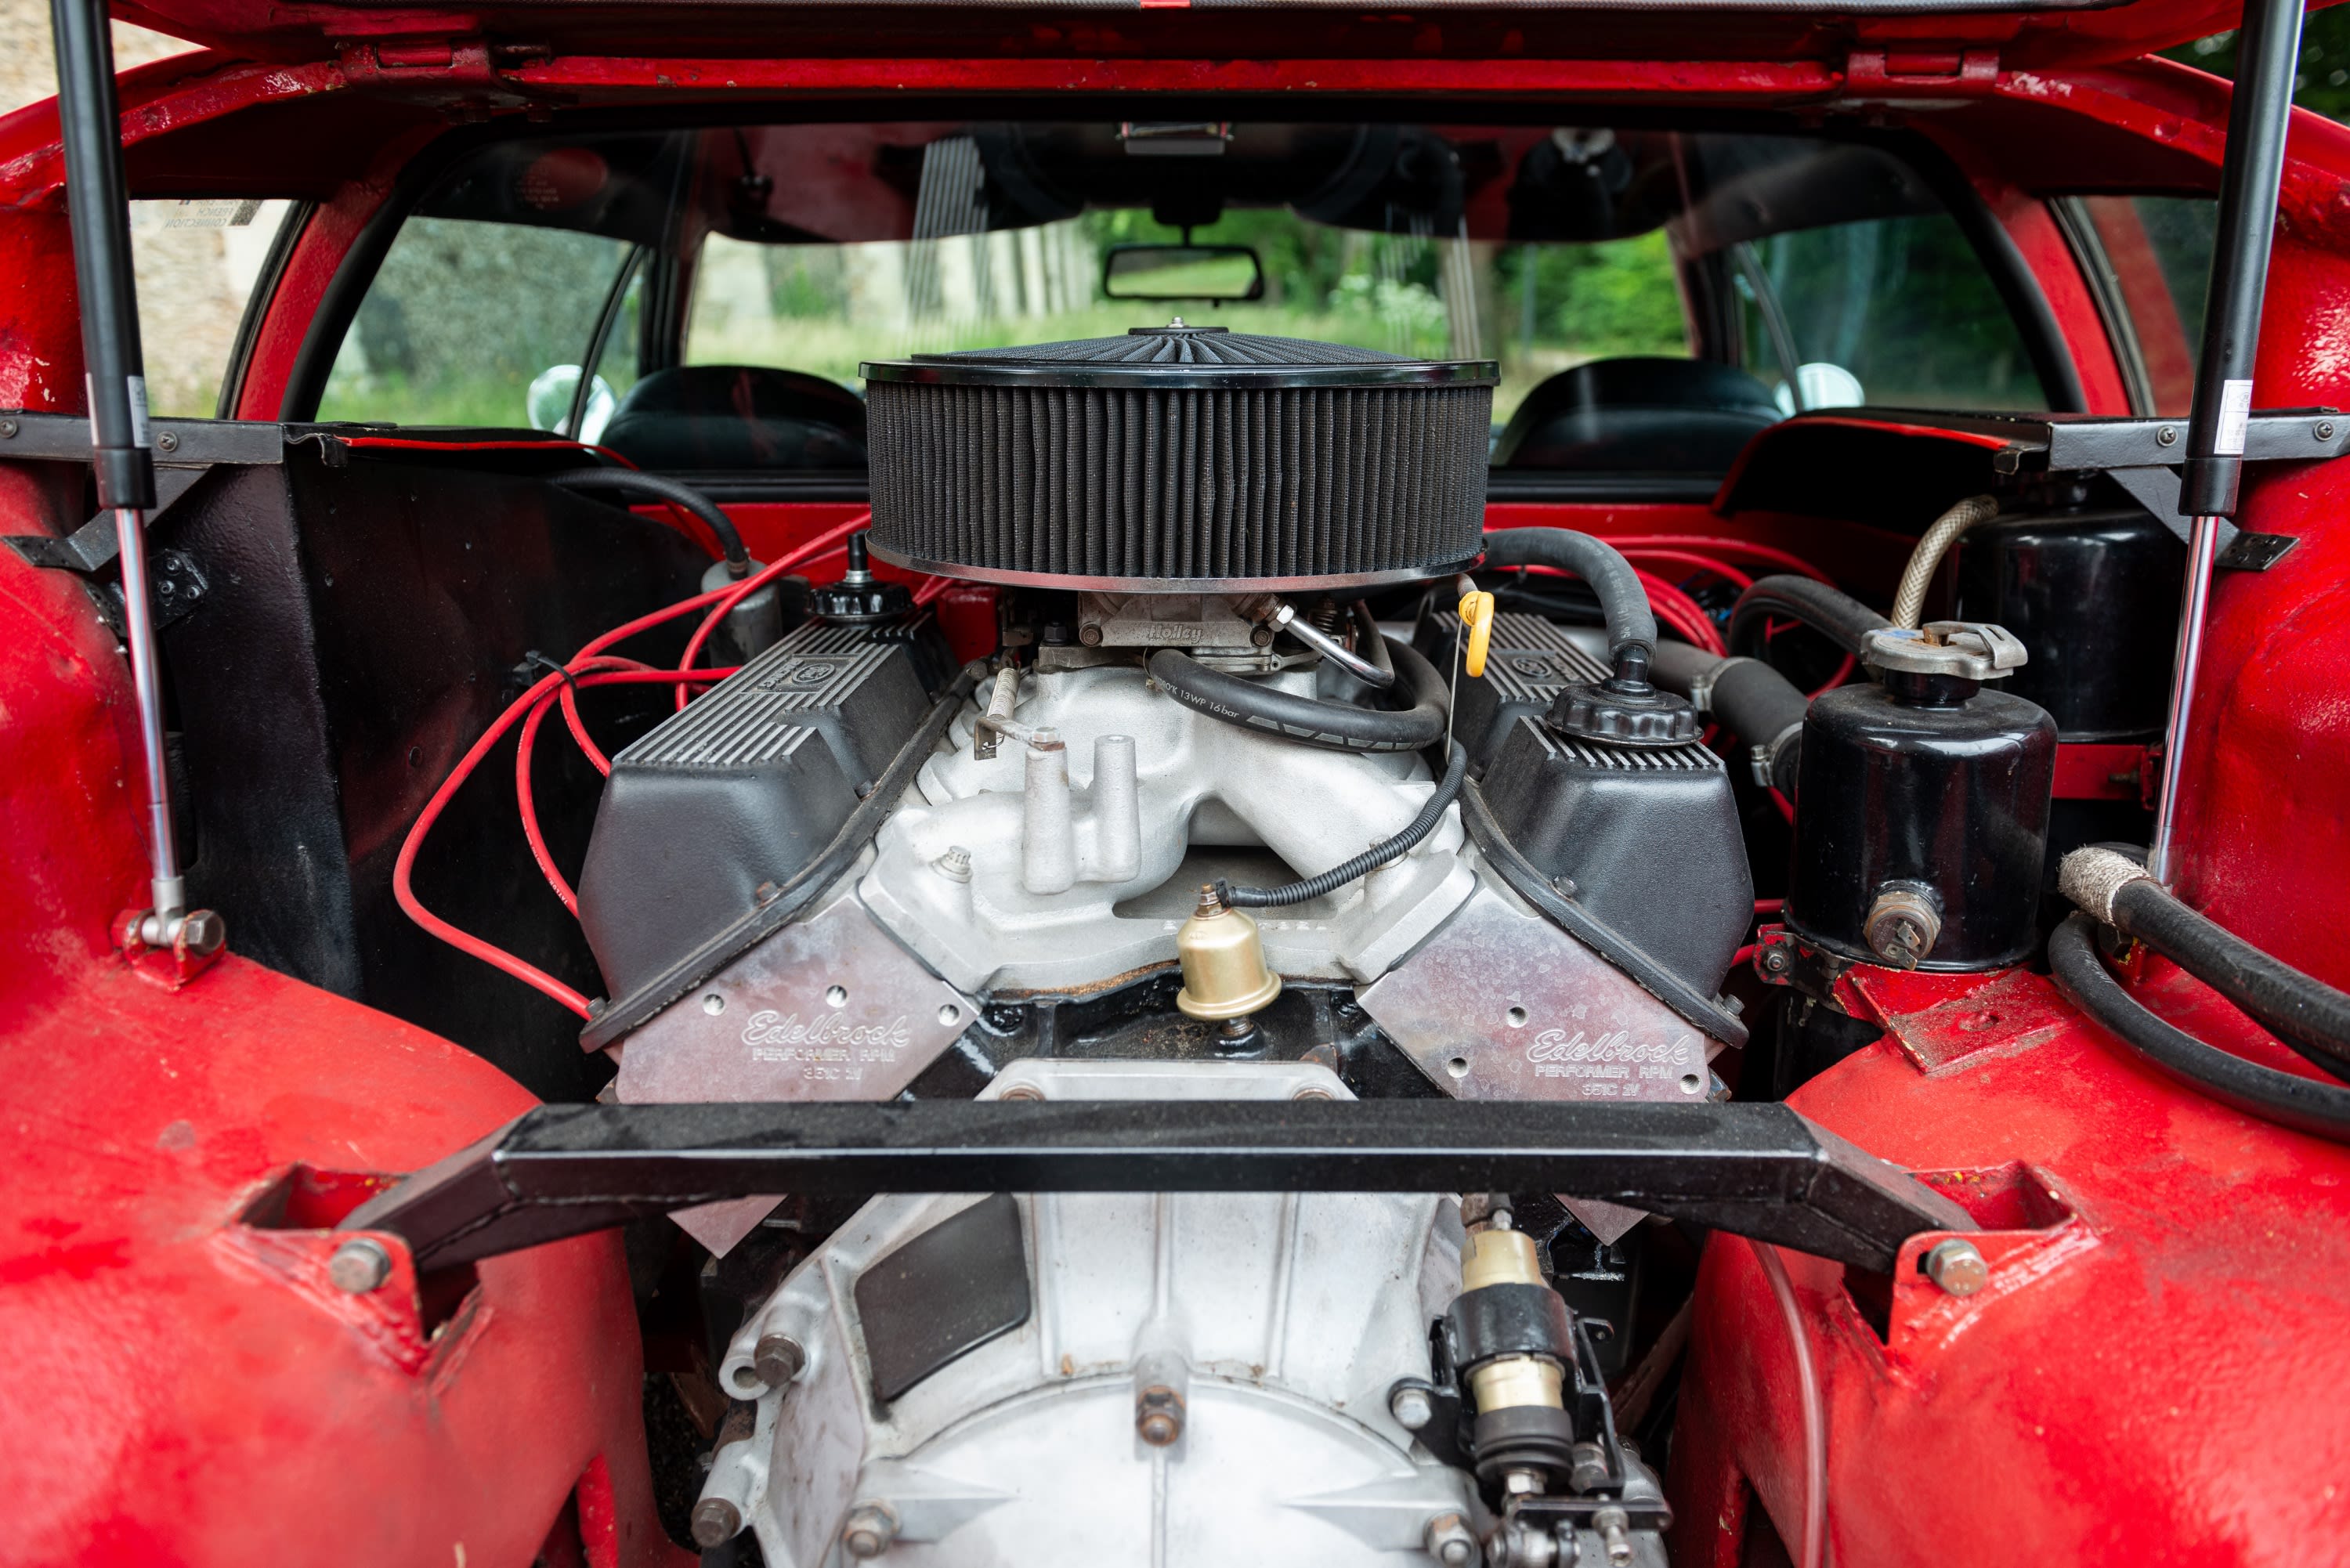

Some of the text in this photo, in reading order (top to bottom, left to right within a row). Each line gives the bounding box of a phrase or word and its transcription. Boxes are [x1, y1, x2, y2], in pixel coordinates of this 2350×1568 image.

[1148, 624, 1203, 644] Holley
[1180, 689, 1206, 706] 13WP
[741, 1010, 913, 1048] Edelbrock
[1526, 1028, 1692, 1065] Edelbrock
[752, 1048, 896, 1063] PERFORMER RPM
[1535, 1064, 1673, 1079] PERFORMER RPM
[1581, 1082, 1641, 1097] 351C 2V
